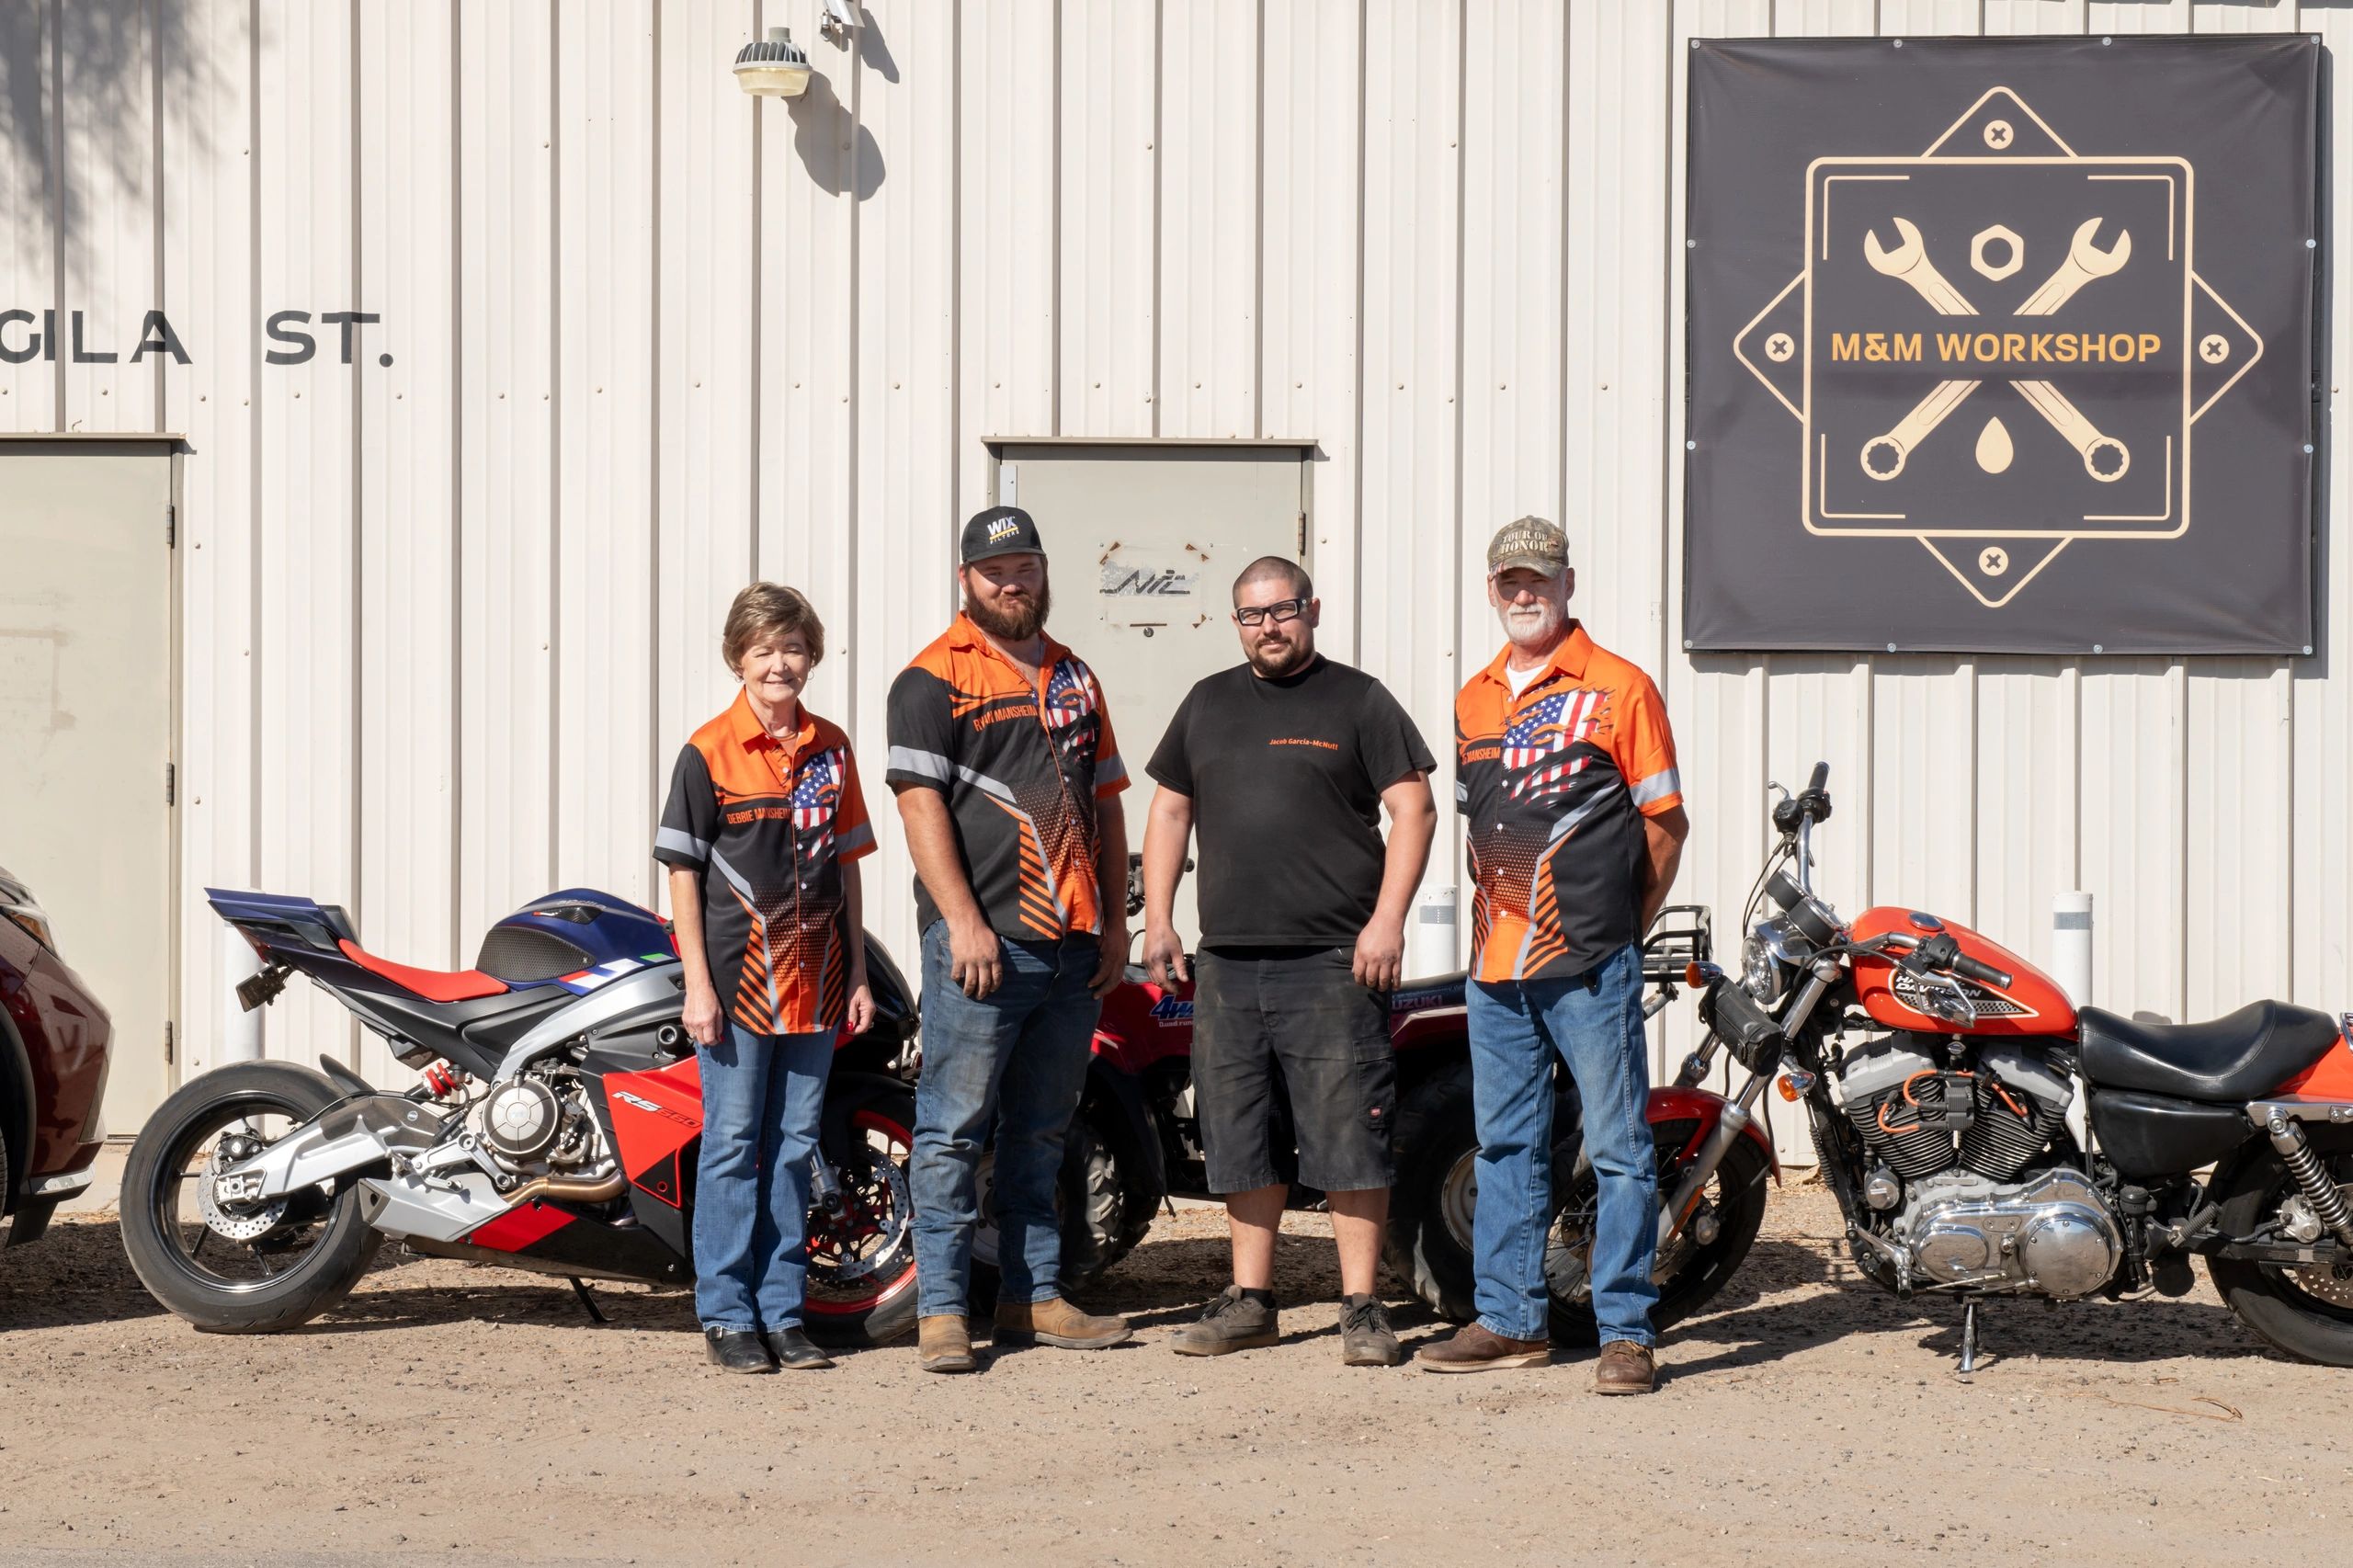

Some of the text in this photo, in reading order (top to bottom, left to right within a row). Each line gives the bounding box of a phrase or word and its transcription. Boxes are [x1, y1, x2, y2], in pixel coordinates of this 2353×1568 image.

[0, 309, 394, 368] GILA ST.
[1832, 333, 2161, 362] M&M WORKSHOP
[987, 516, 1016, 536] WIX
[990, 529, 1019, 544] FILTERS
[1503, 530, 1548, 543] TOUR OF
[1500, 540, 1549, 554] HONOR
[973, 704, 1038, 732] RYAN MANSHEIM
[1288, 738, 1338, 750] Garcia-McNutt
[726, 810, 754, 824] DEBBIE
[1150, 994, 1193, 1020] 4W
[1392, 994, 1443, 1010] UZUKI
